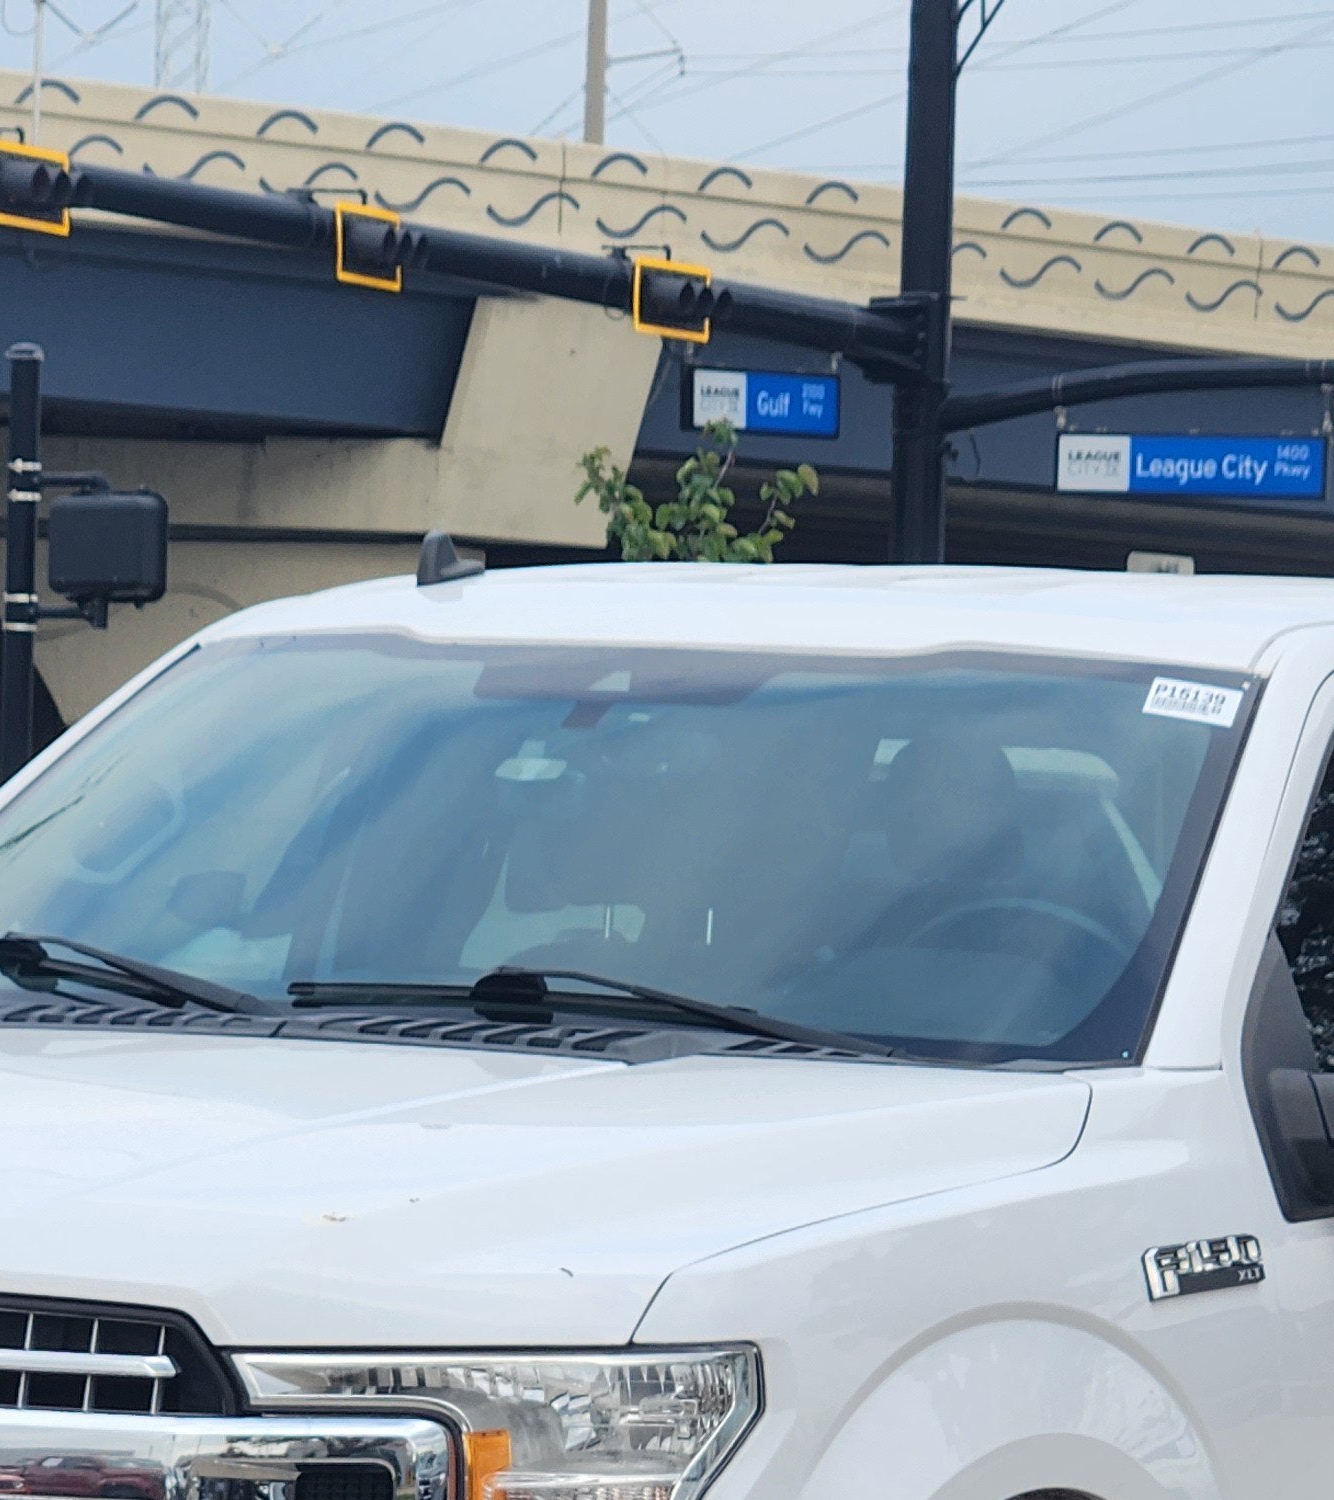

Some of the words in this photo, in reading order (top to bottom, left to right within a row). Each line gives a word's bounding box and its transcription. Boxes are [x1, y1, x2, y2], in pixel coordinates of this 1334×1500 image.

[756, 390, 791, 417] Gulf
[1068, 450, 1121, 462] LEAGUE
[1135, 452, 1218, 485] League
[1221, 454, 1268, 485] City
[1237, 1266, 1262, 1282] XLT
